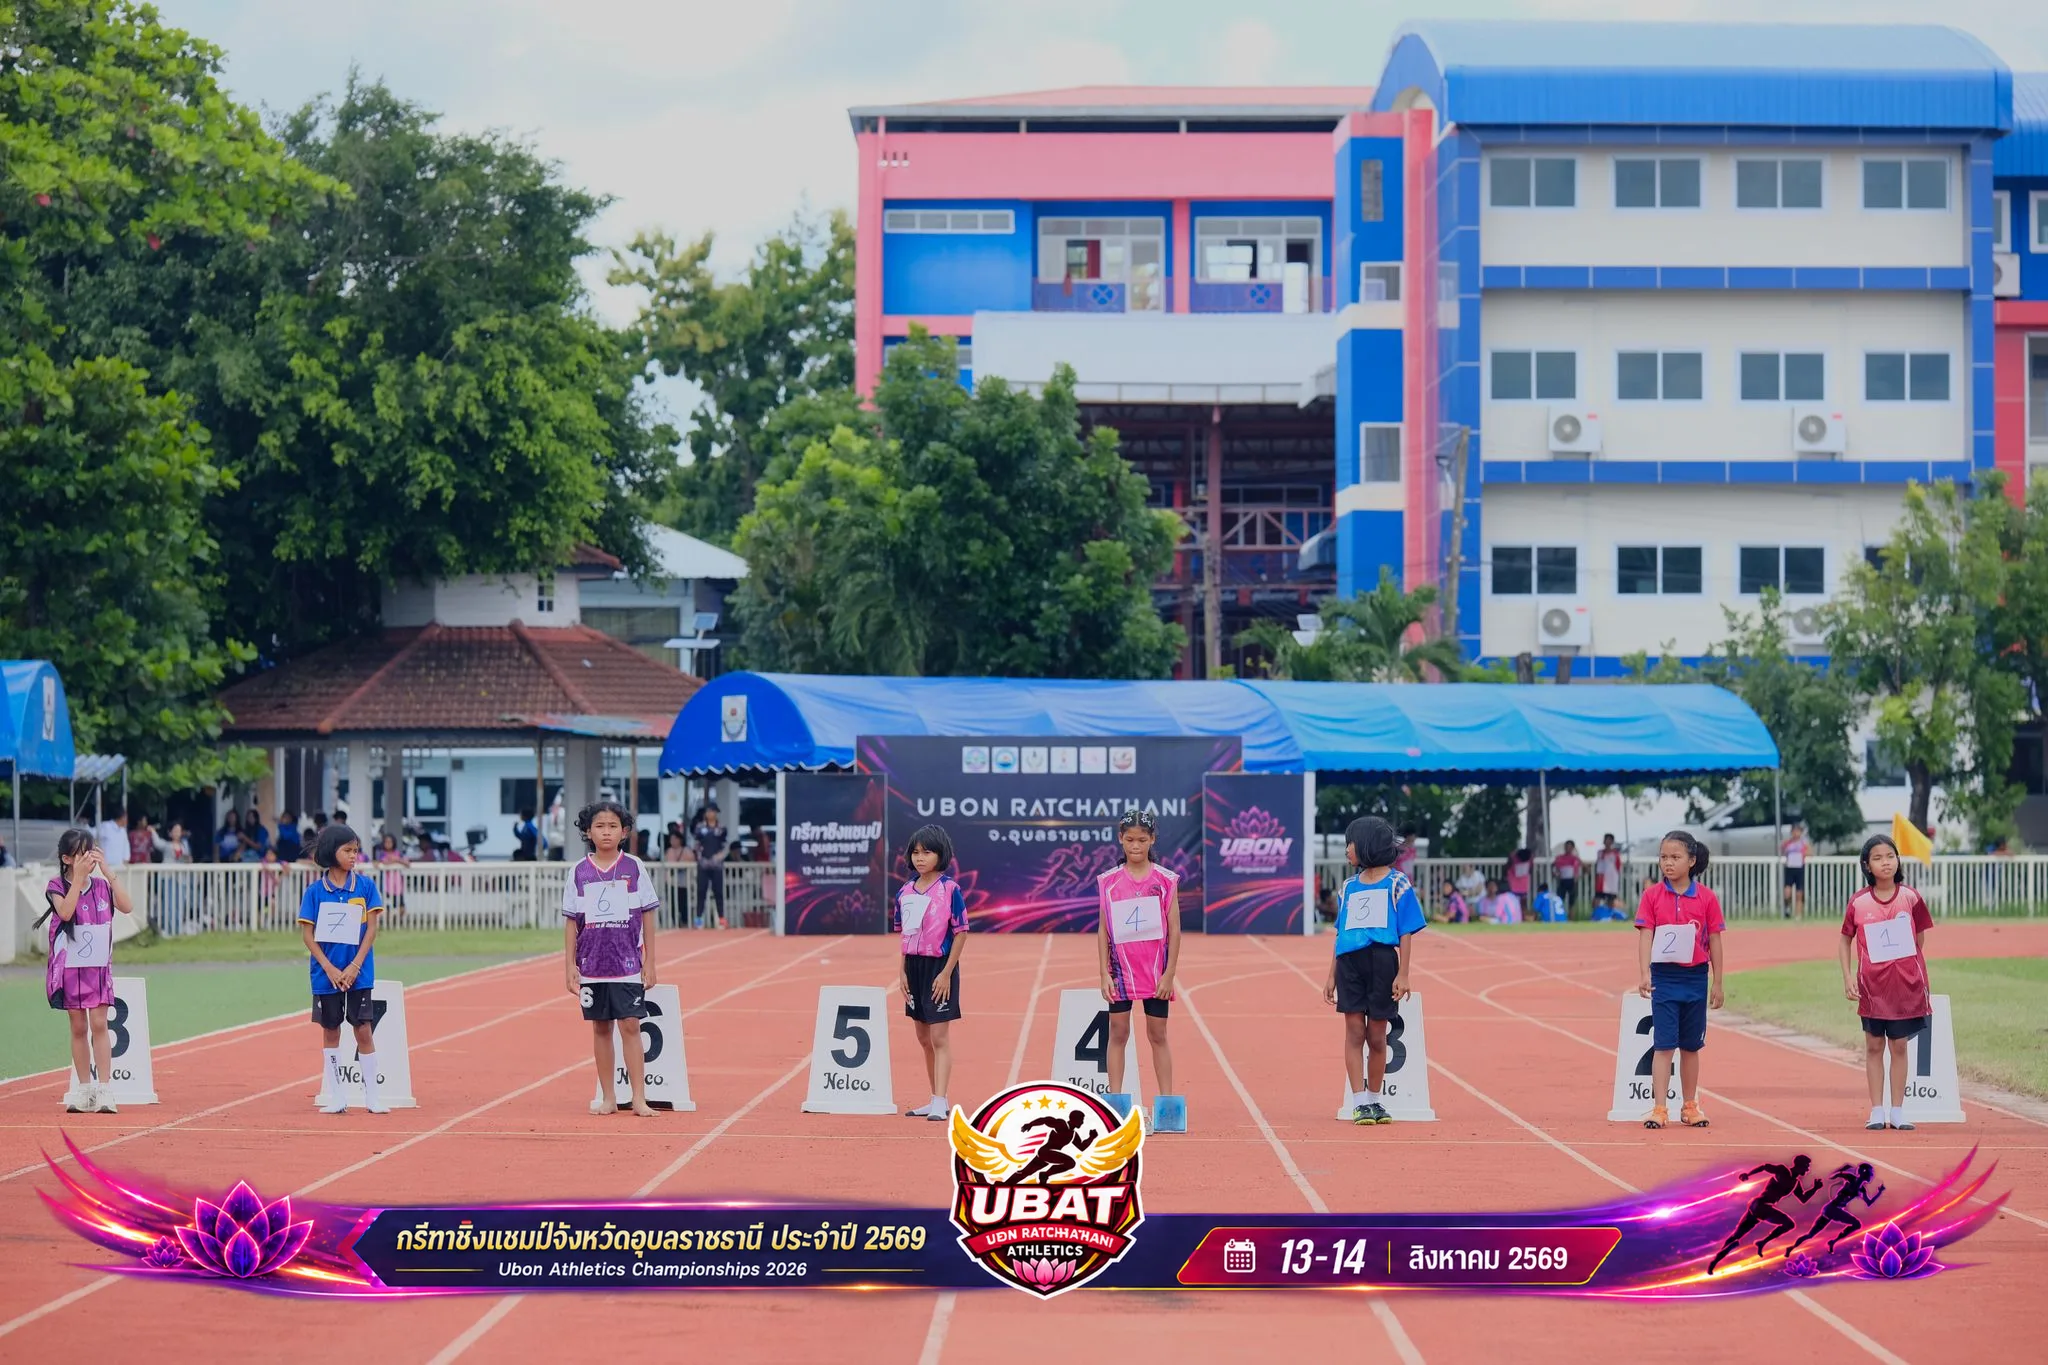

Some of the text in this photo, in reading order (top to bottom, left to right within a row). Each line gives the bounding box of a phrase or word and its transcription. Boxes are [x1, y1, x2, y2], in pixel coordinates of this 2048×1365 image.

[917, 797, 1187, 817] UBON RATCHATHANI
[1219, 837, 1293, 857] UBON
[597, 886, 612, 913] 6
[1355, 897, 1371, 921] 3
[327, 912, 347, 934] 7
[1125, 905, 1147, 931] 4
[77, 930, 93, 958] 8
[1661, 931, 1677, 954] 2
[1880, 927, 1899, 948] 1
[831, 1005, 871, 1069] 5
[1074, 1010, 1109, 1073] 4
[616, 1067, 664, 1086] Nco
[823, 1071, 872, 1091] Nelco
